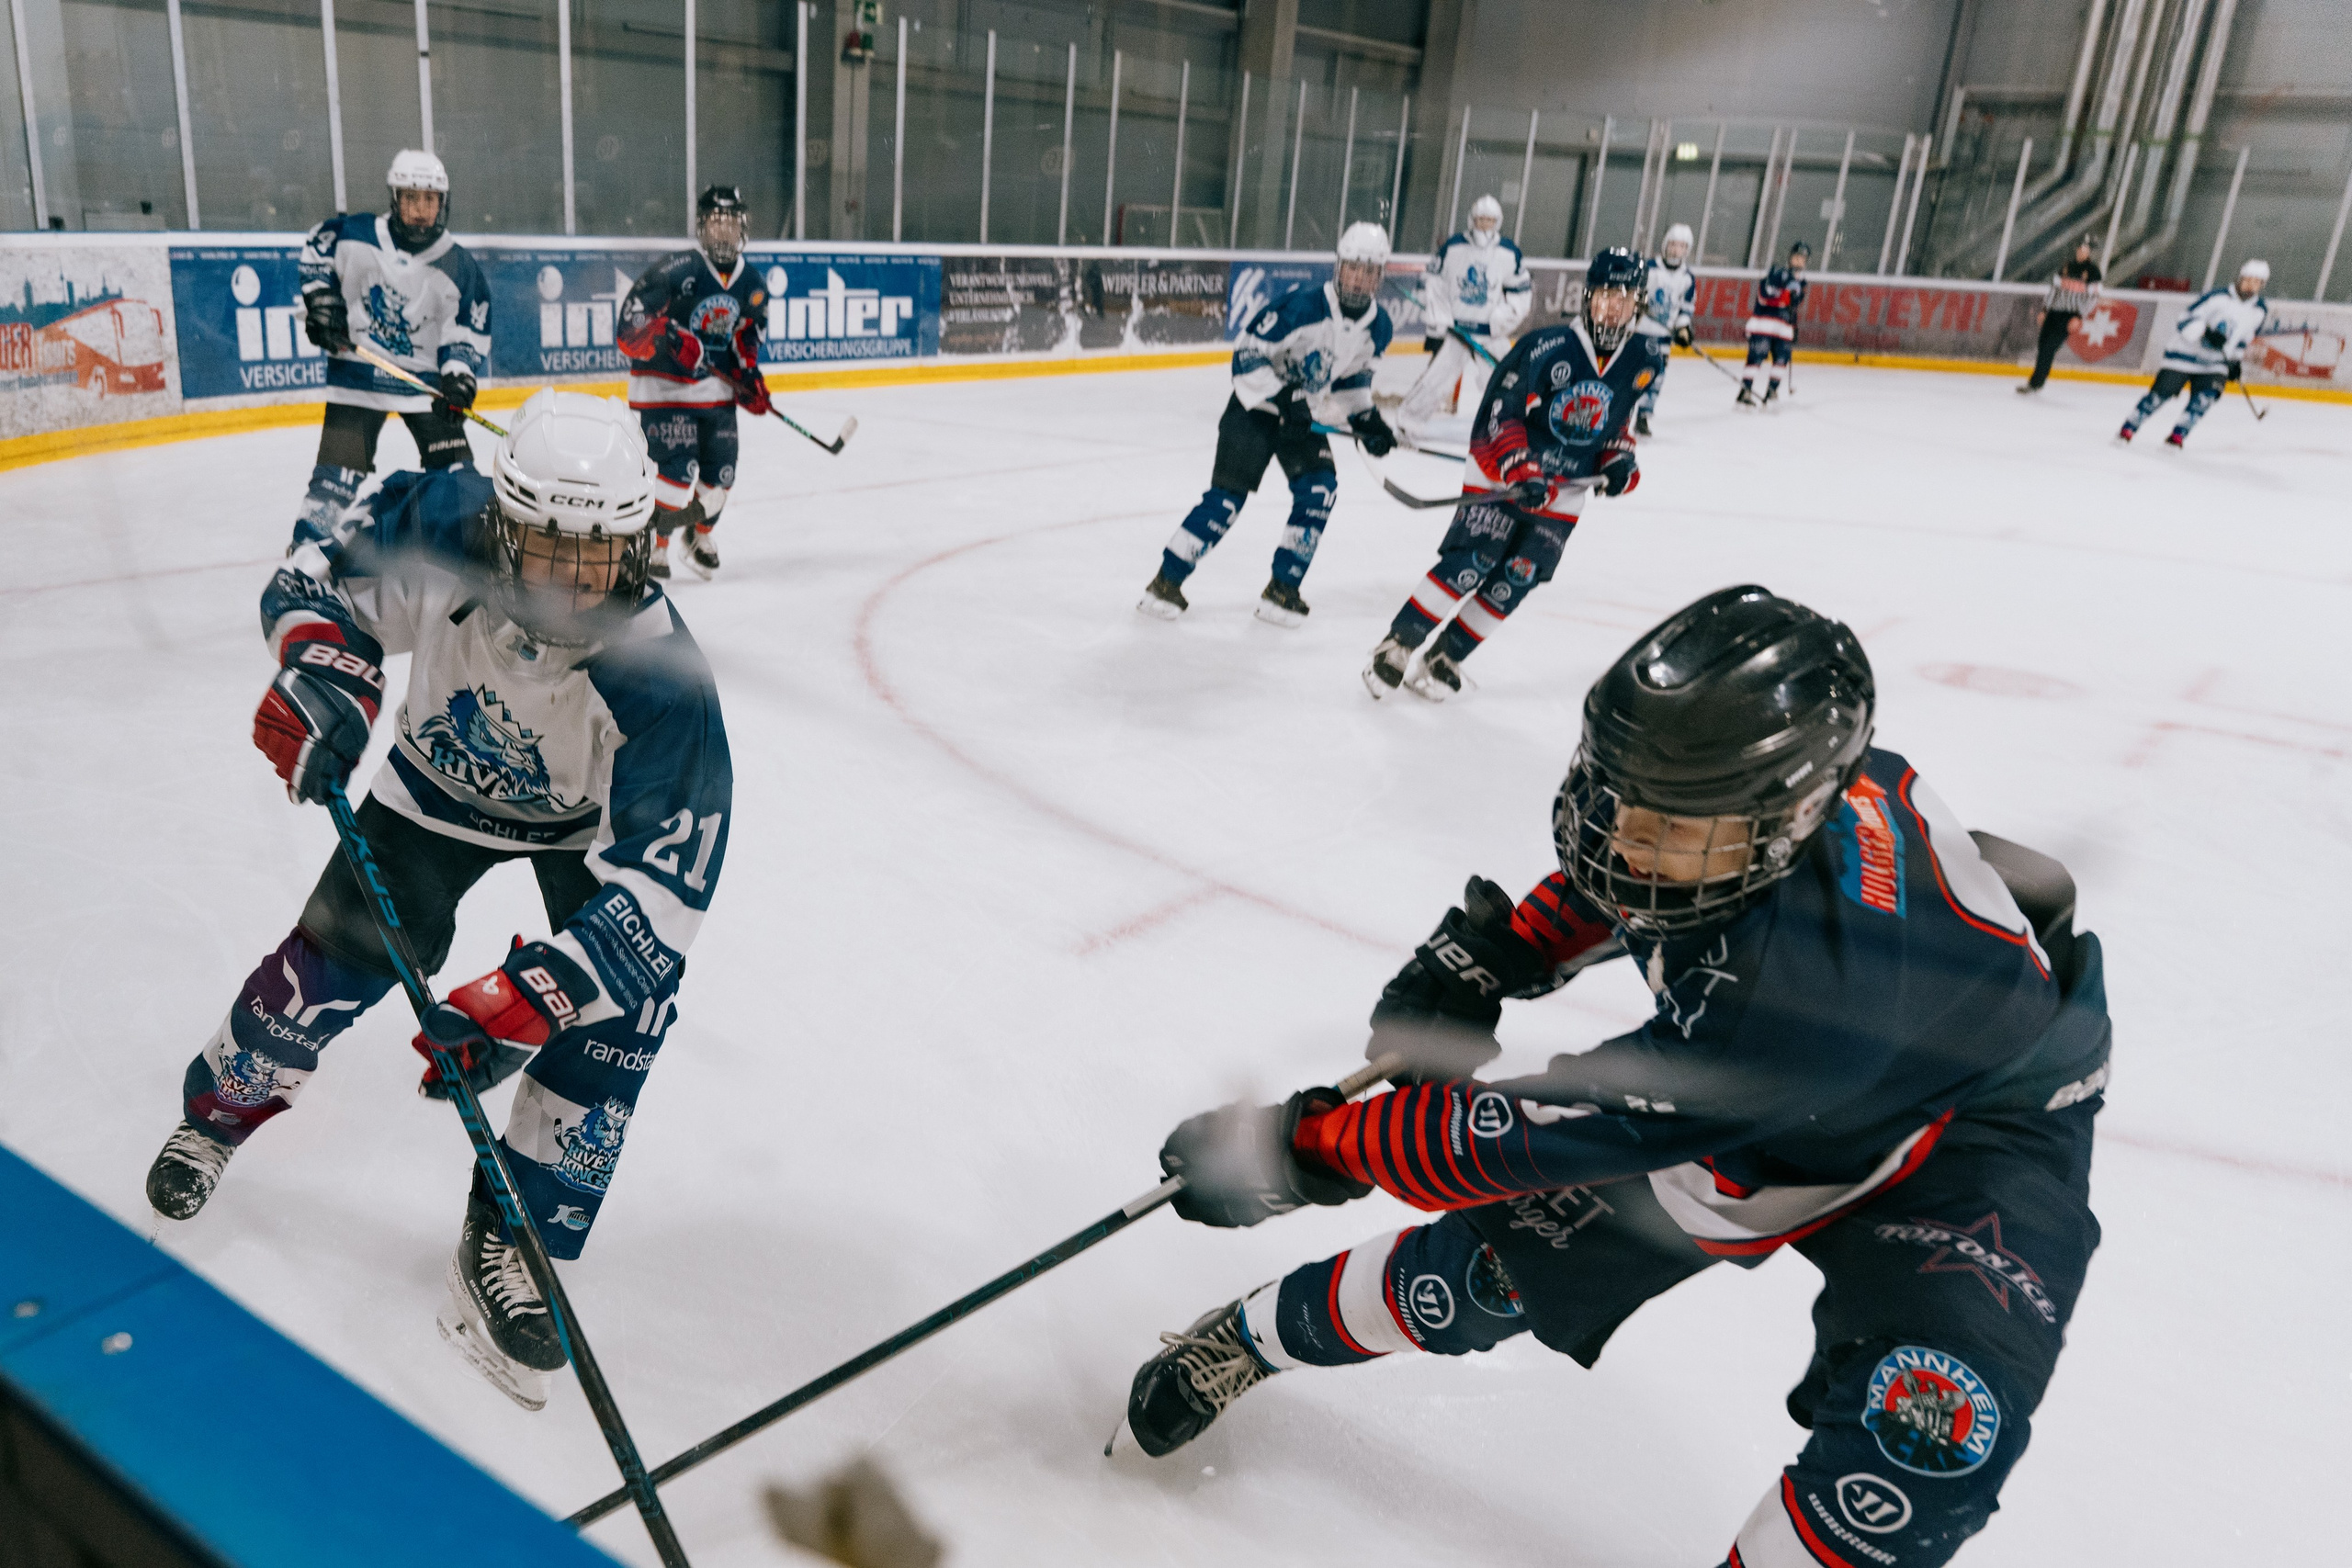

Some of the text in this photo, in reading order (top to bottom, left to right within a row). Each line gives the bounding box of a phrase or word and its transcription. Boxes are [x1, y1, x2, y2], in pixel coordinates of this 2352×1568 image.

[766, 265, 913, 341] inter
[240, 363, 327, 389] VERSICHE
[766, 338, 912, 361] VERSICHERUNGSGRUPPE
[549, 493, 606, 512] CCM
[642, 807, 722, 893] 21
[1874, 1223, 2057, 1325] TOP ON ICE
[1869, 1348, 1994, 1457] MANNHEIM
